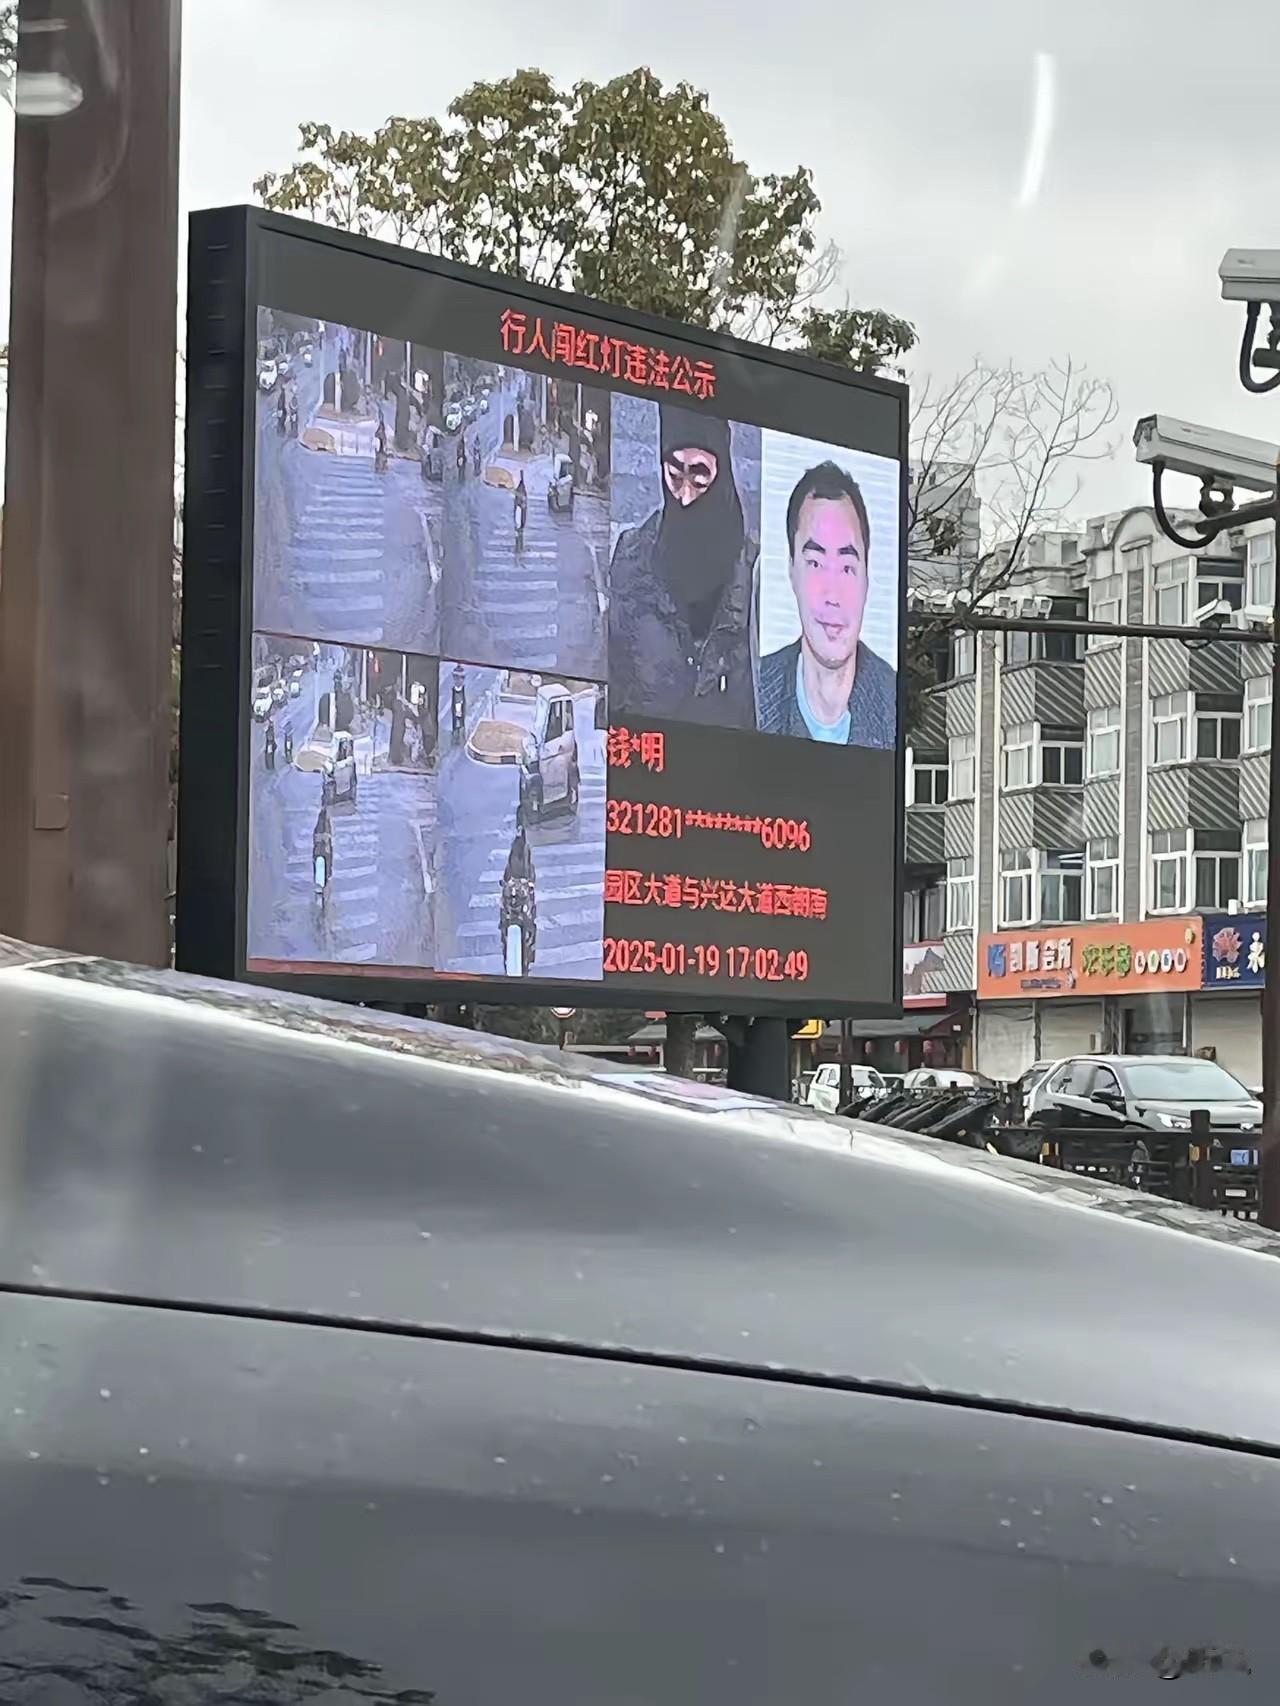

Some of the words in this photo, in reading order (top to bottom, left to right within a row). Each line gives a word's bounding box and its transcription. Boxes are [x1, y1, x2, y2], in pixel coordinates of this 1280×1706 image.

[501, 308, 716, 399] 行人闯红灯违法公示
[603, 938, 720, 977] 2025-01-19
